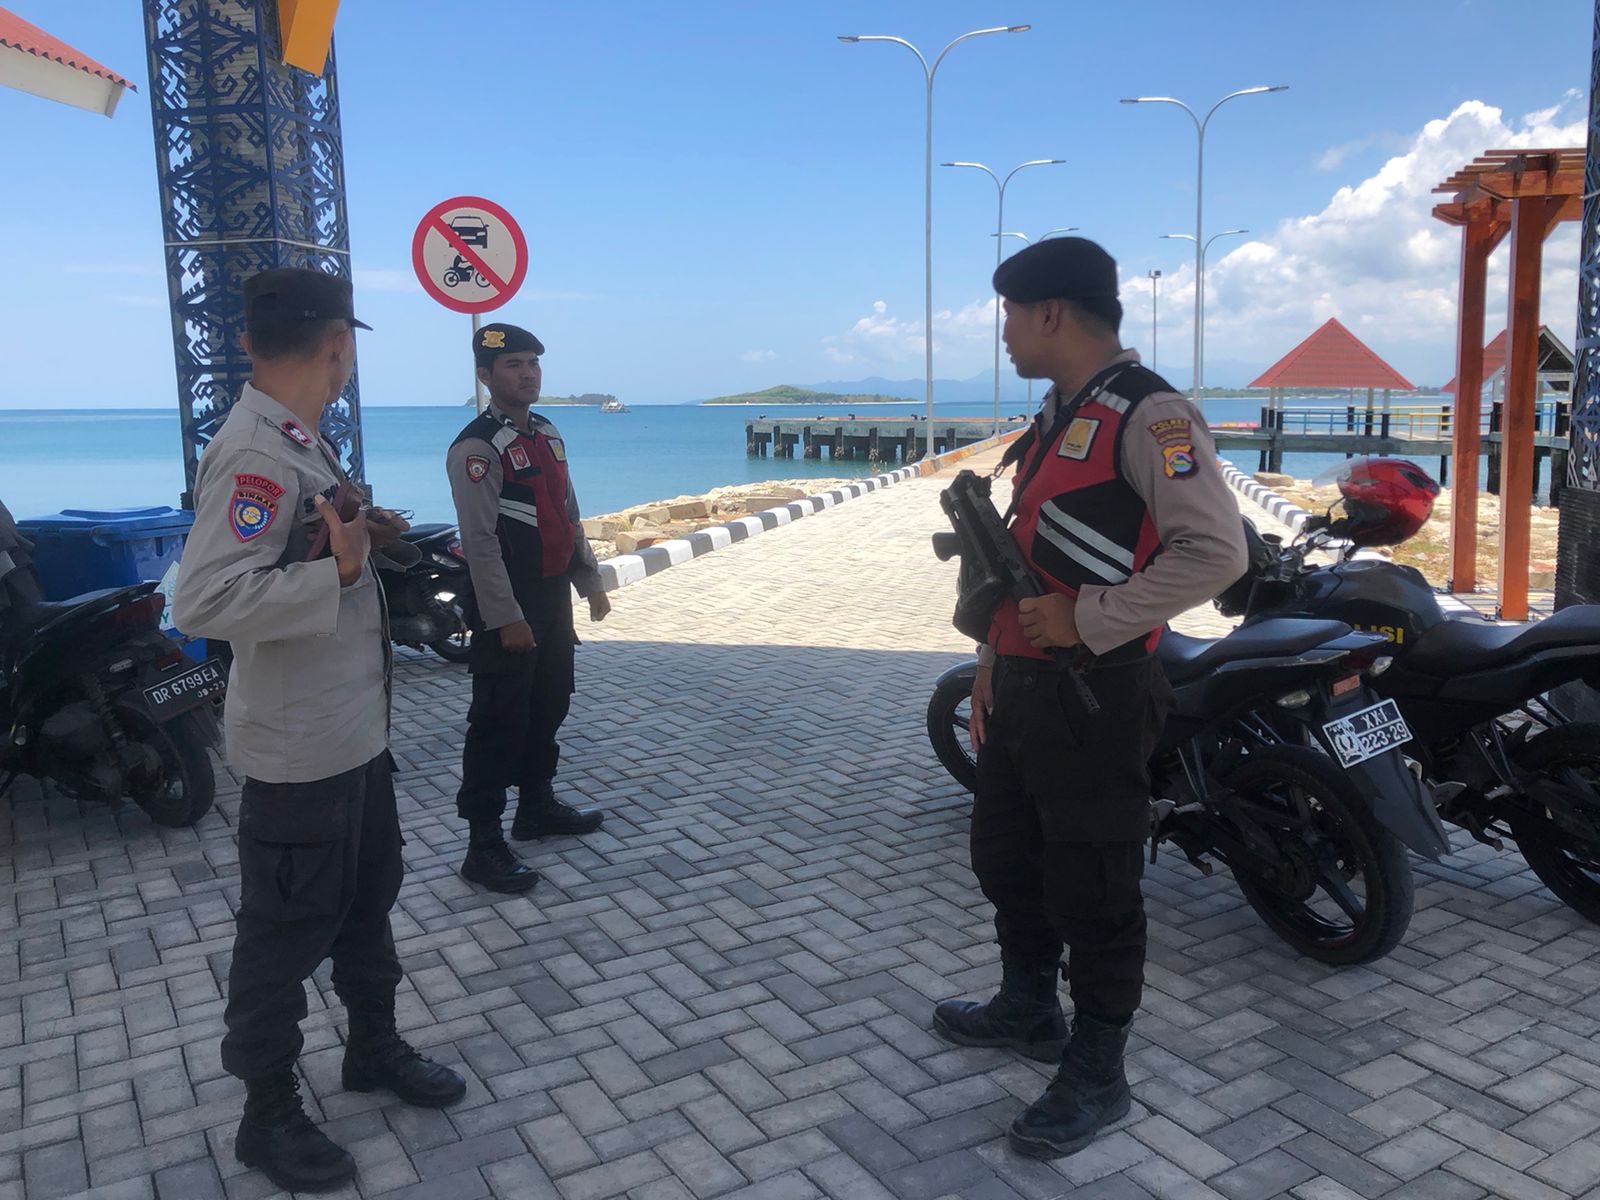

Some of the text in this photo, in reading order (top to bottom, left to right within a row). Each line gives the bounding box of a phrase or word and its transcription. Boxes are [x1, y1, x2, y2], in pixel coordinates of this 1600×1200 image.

[240, 476, 280, 496] PELOPOR
[152, 667, 219, 704] DR 6799 EA
